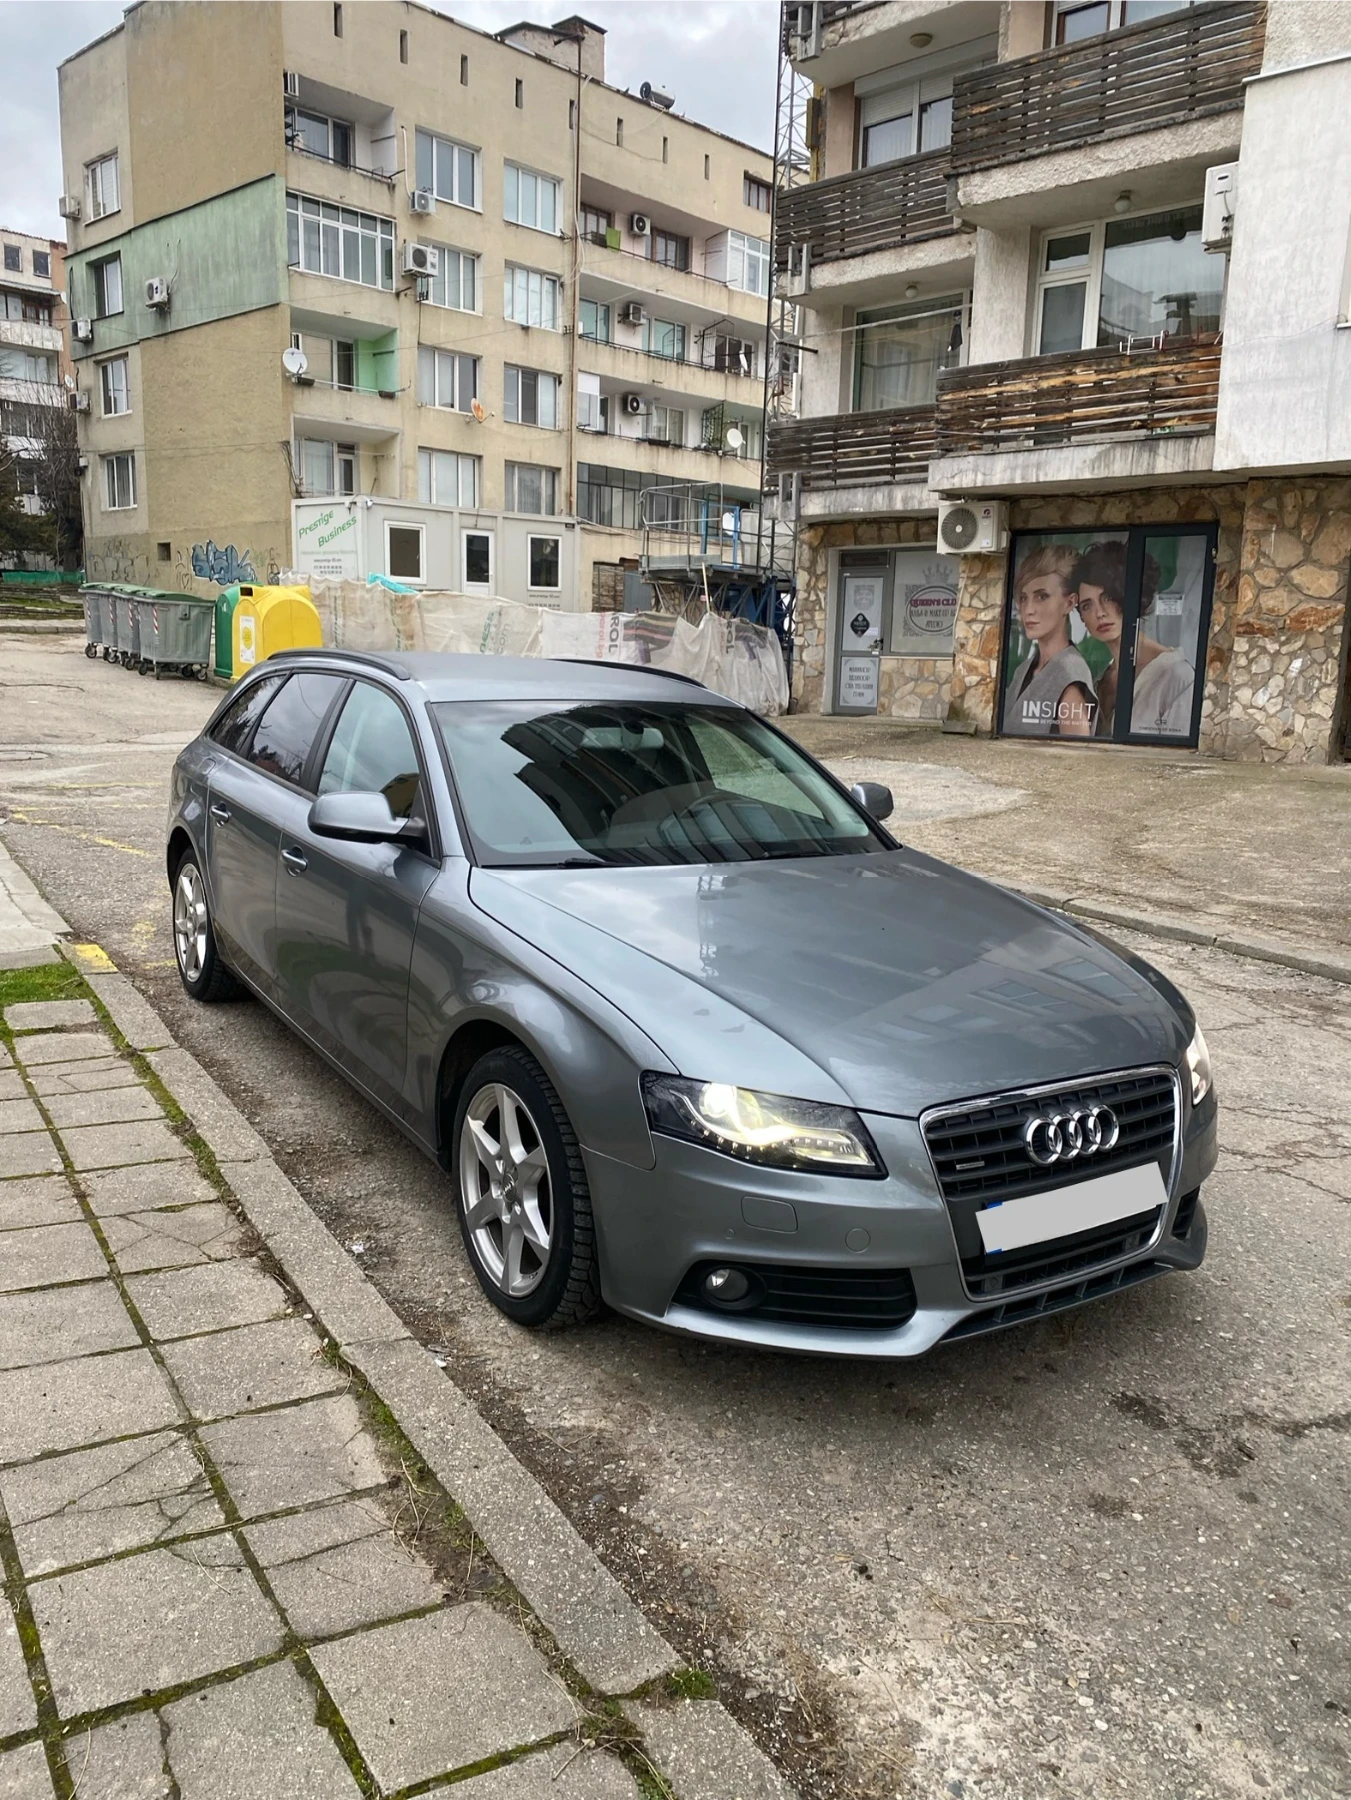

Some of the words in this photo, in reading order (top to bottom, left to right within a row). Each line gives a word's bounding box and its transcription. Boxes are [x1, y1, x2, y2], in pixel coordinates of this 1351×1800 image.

[299, 510, 334, 539] Prestige
[318, 516, 357, 547] Business
[1022, 700, 1096, 720] INSIGHT
